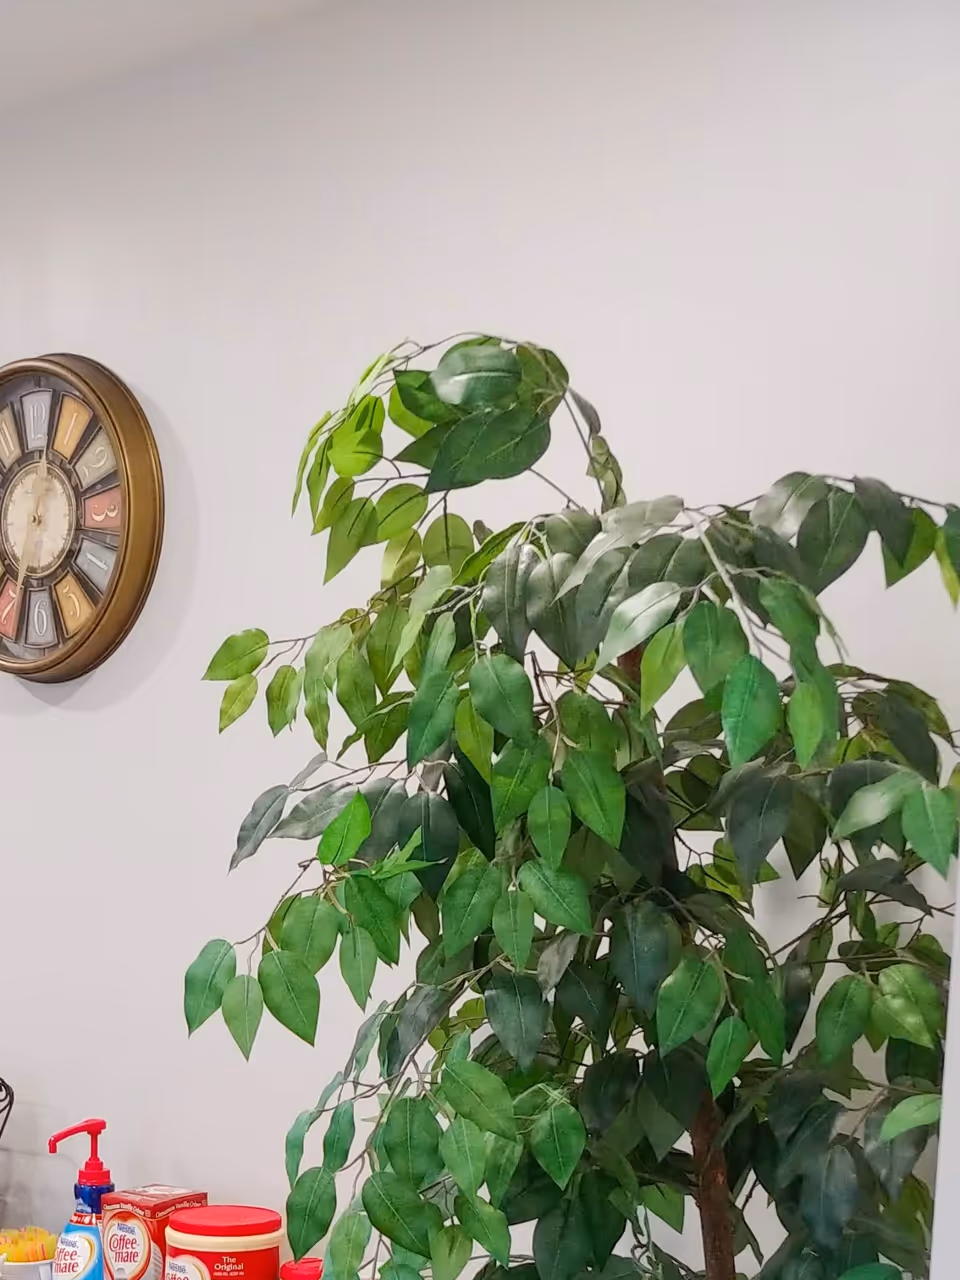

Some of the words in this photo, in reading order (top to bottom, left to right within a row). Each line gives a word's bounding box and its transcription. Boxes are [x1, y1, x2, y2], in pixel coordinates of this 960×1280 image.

[30, 401, 47, 441] 12
[64, 412, 78, 445] 1
[91, 503, 118, 522] 3
[1, 588, 18, 624] 7
[34, 600, 48, 636] 6
[114, 1251, 139, 1263] mate
[213, 1262, 244, 1272] Original
[221, 1256, 237, 1264] The
